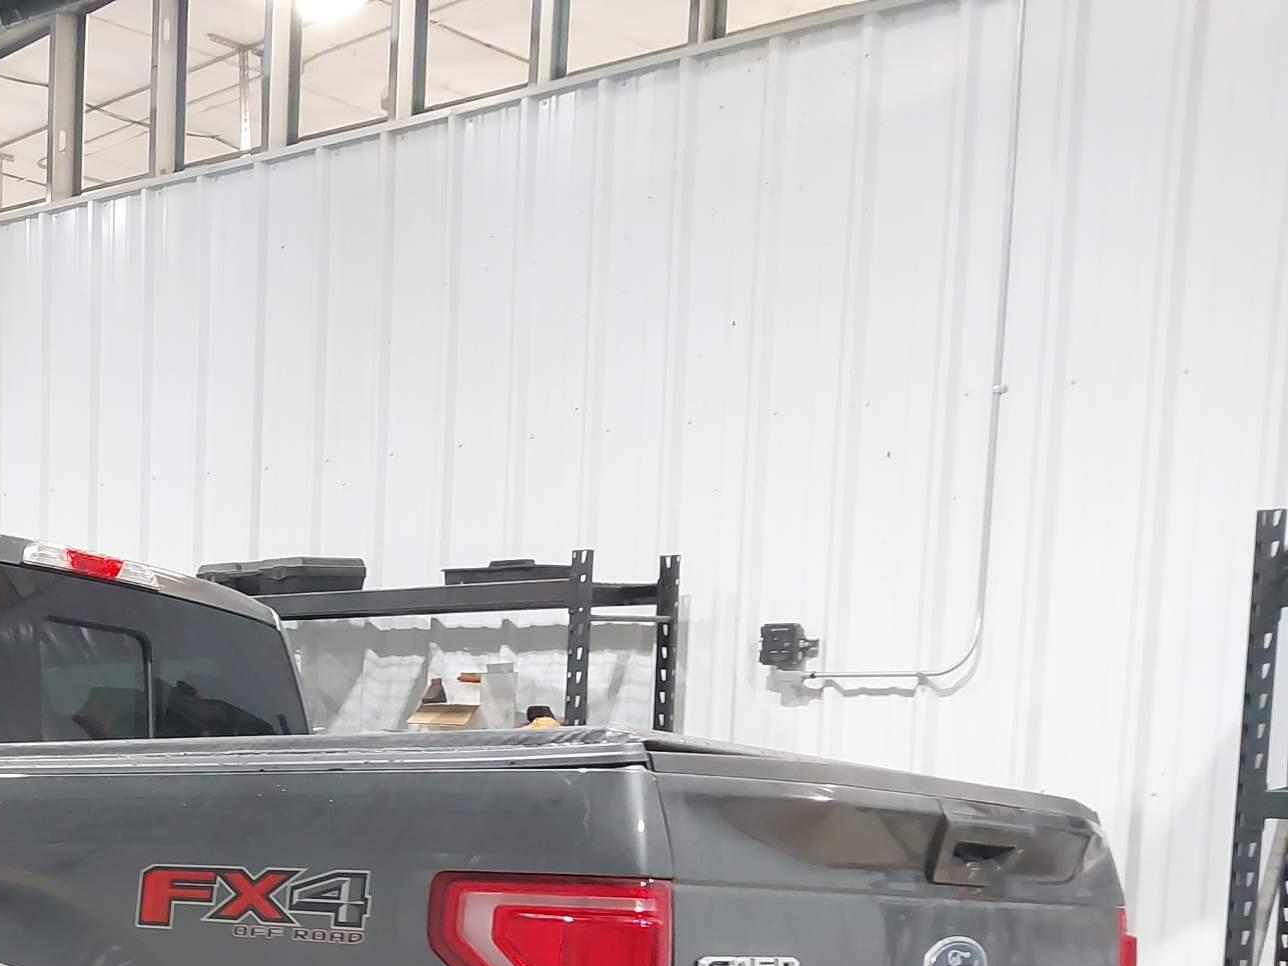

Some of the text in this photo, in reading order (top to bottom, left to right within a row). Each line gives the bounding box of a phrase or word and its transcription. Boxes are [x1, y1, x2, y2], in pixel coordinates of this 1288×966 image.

[135, 864, 372, 930] FX4
[232, 925, 365, 944] OFF ROAD
